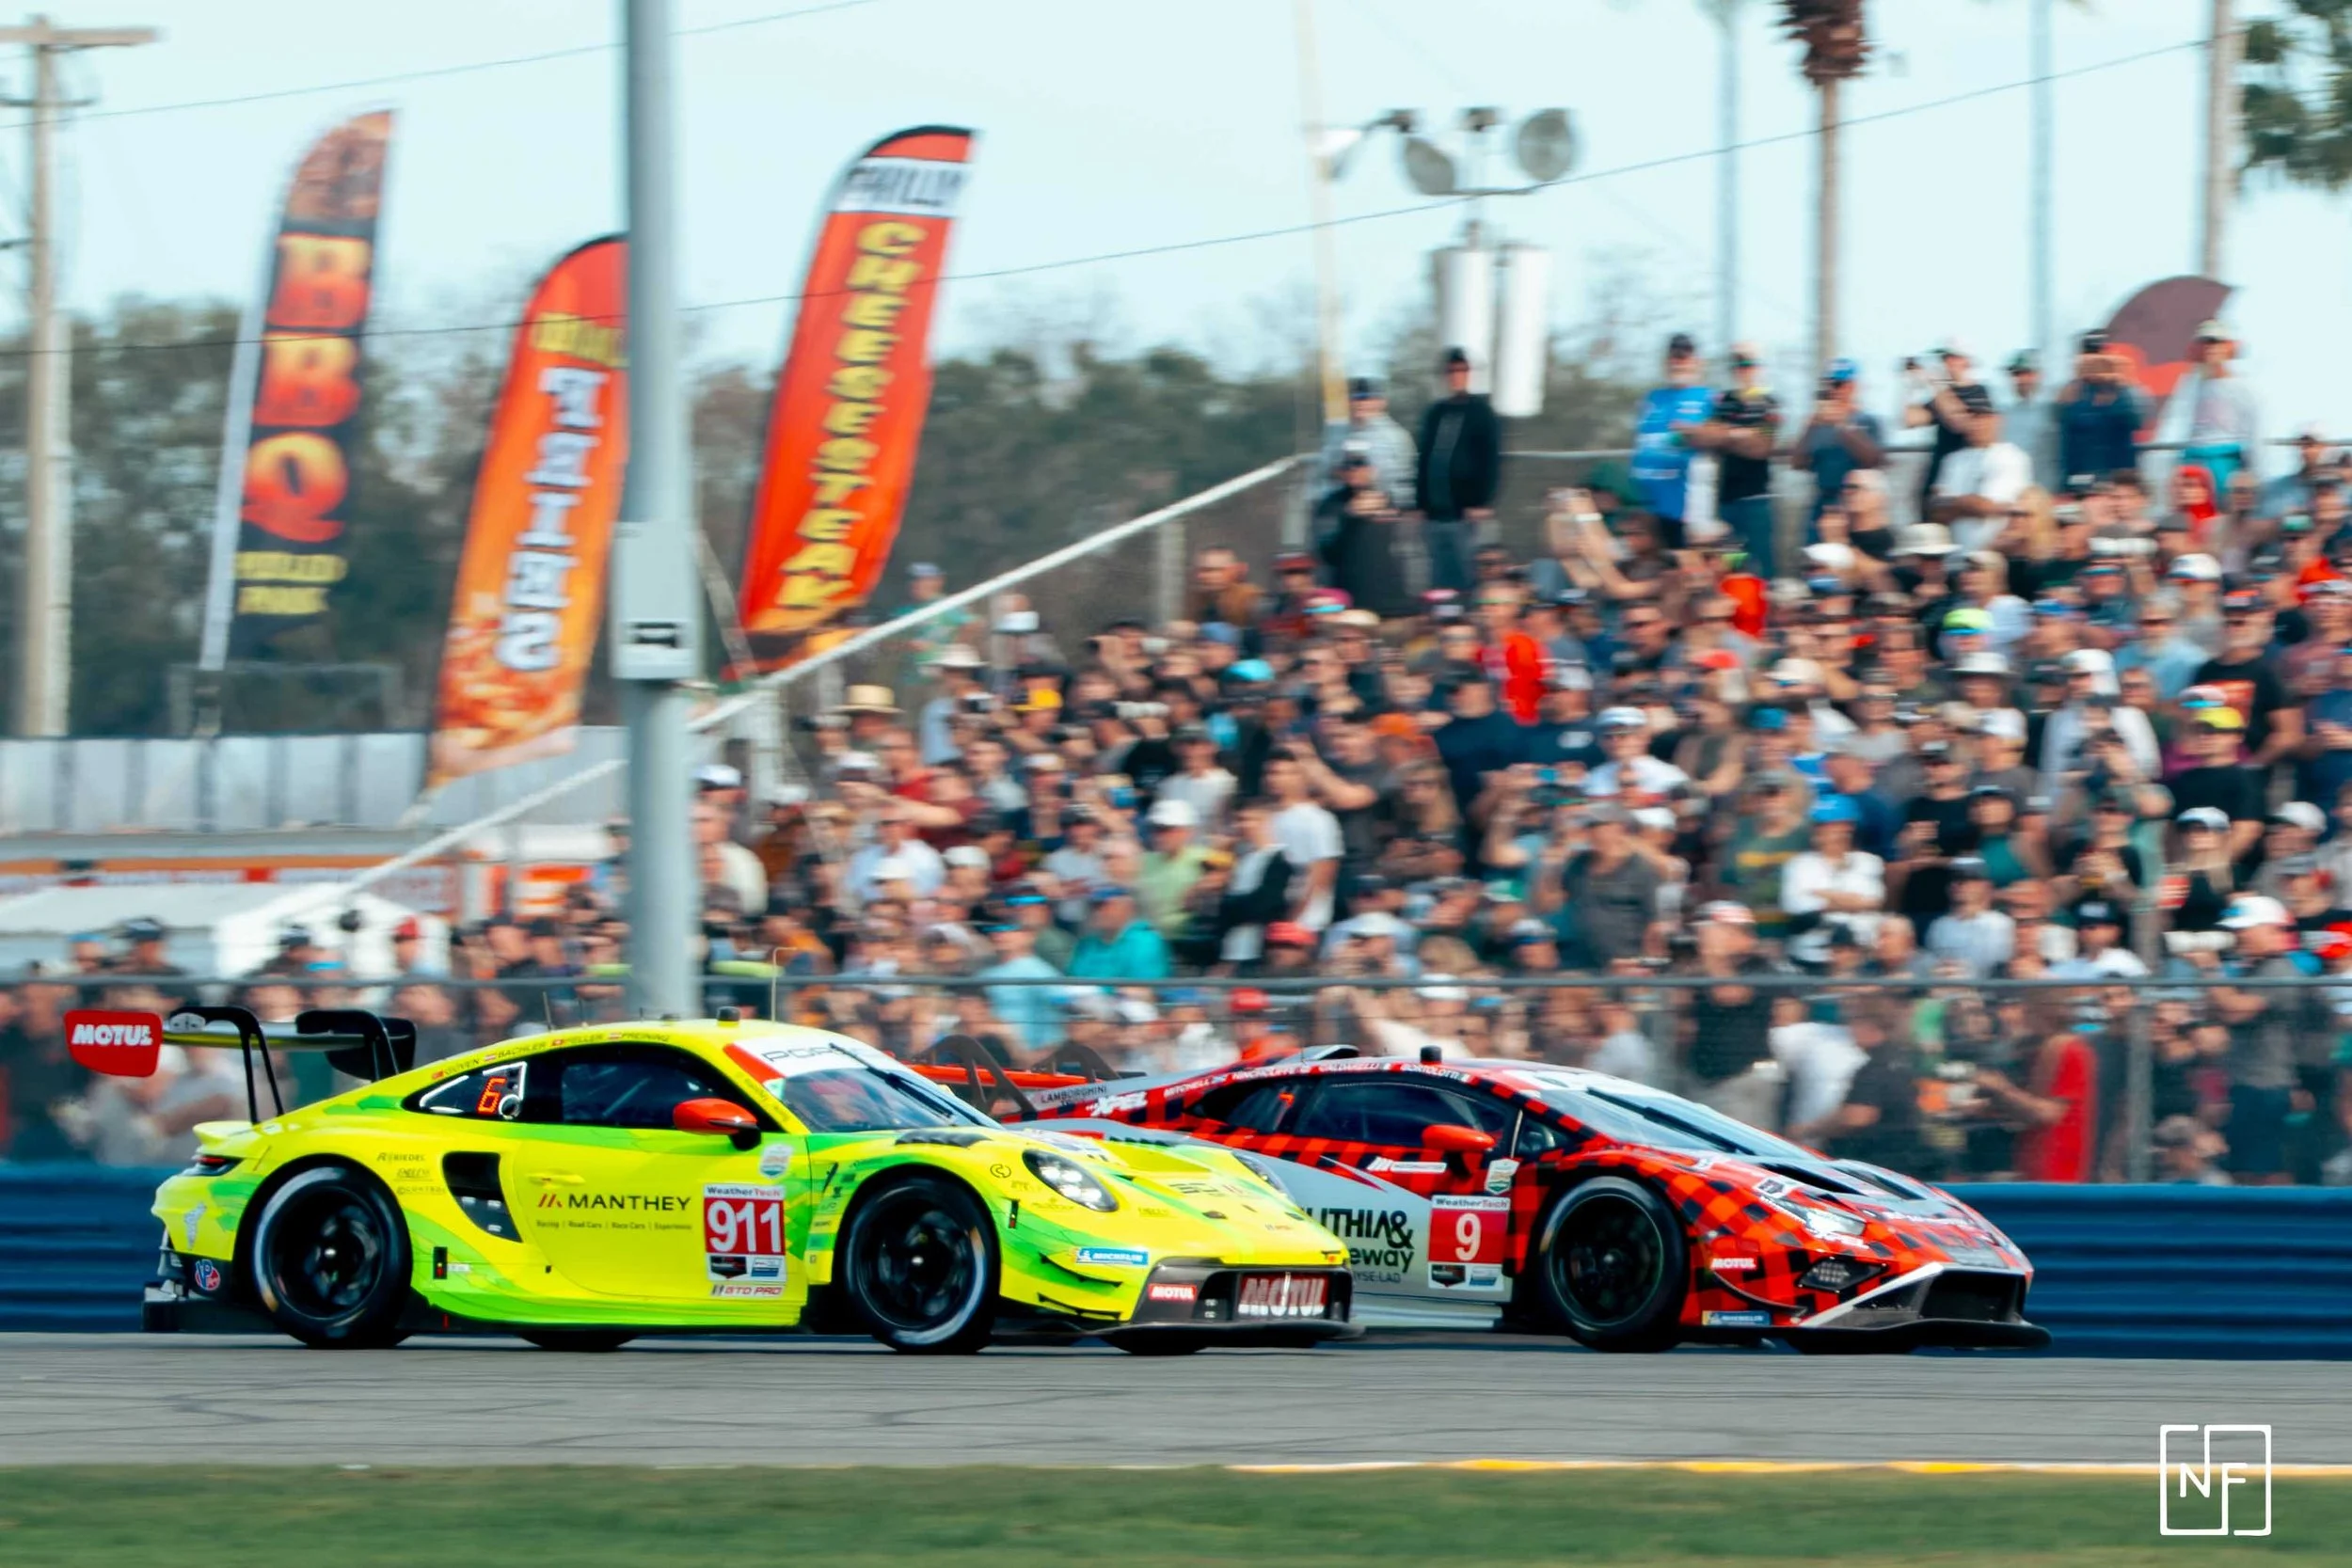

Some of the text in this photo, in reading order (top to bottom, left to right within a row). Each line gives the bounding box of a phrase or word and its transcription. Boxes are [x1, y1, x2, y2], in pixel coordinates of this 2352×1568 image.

[241, 232, 371, 543] BBQ
[775, 221, 929, 608] CHEESESTEAK
[72, 1023, 153, 1046] MOTUL
[476, 1075, 508, 1117] 6
[1041, 1085, 1107, 1103] LAMBORGHINI
[568, 1194, 691, 1212] MANTHEY
[707, 1186, 781, 1197] WeatherTech
[1436, 1197, 1508, 1208] WeatherTech
[707, 1199, 782, 1253] 911
[1307, 1208, 1415, 1248] ITHIA&
[1454, 1212, 1482, 1261] 9
[1349, 1248, 1415, 1274] eway
[1710, 1258, 1756, 1270] MOTUL
[1151, 1286, 1195, 1299] MOTUL
[1237, 1276, 1326, 1317] MOTUL
